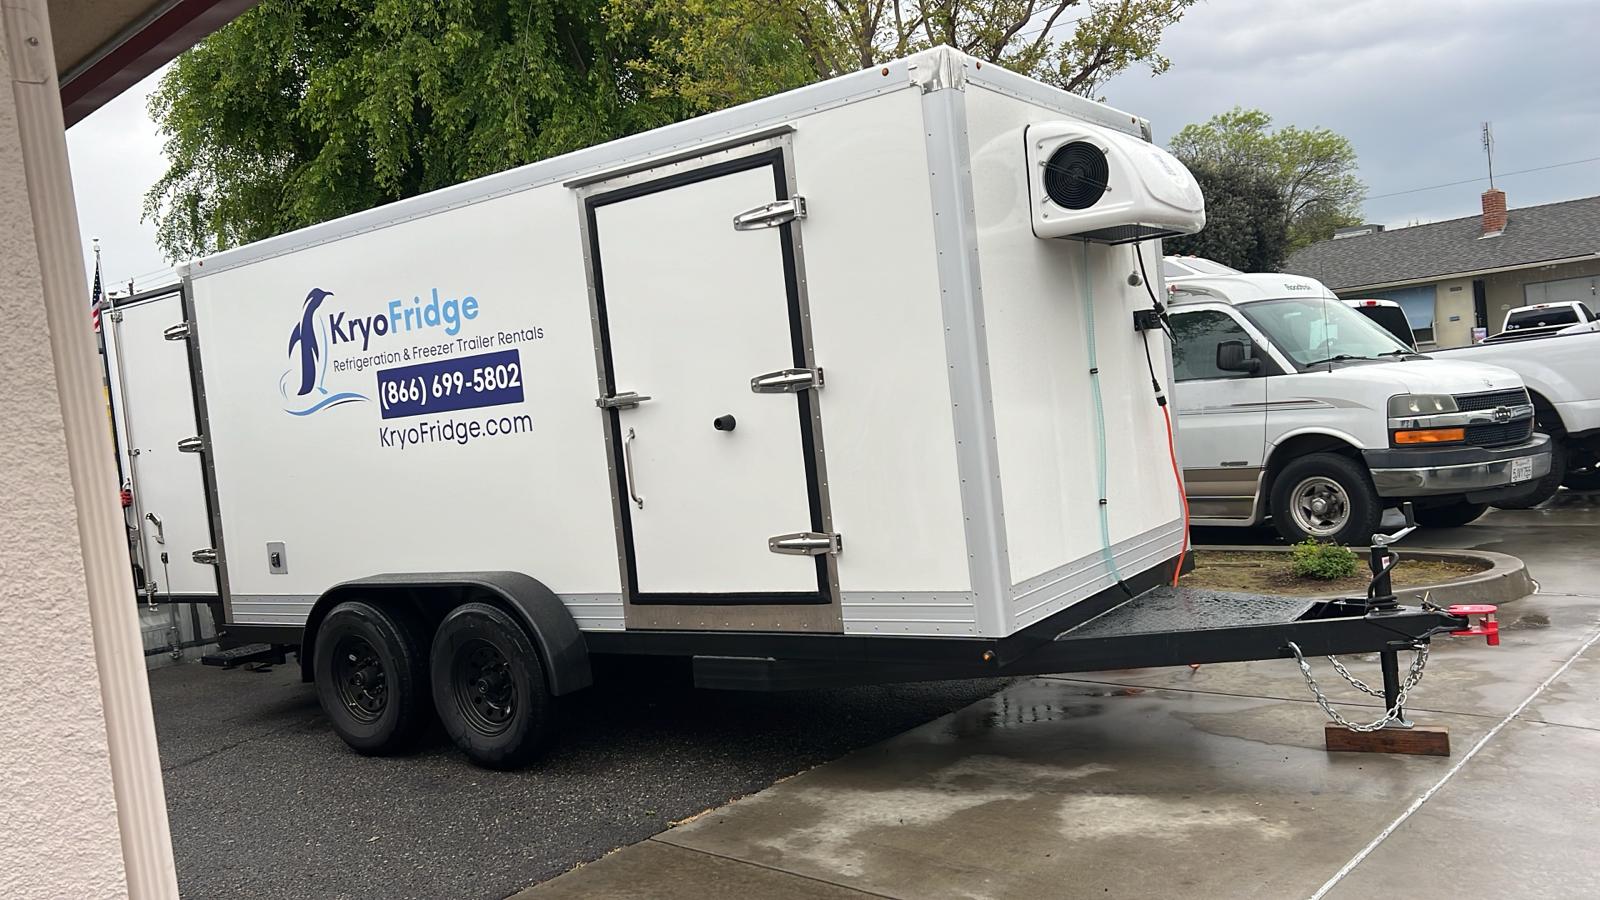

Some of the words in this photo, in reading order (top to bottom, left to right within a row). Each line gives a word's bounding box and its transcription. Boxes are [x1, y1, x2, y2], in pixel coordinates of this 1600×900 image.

[329, 287, 480, 351] KryoFridge
[333, 350, 401, 373] Refrigeration
[403, 348, 410, 361] &
[412, 342, 455, 360] Freezer
[456, 334, 495, 354] Trailer
[497, 326, 544, 346] Rentals
[381, 376, 428, 410] (866)
[432, 362, 521, 399] 699-5802
[379, 414, 534, 450] KryoFridge.com
